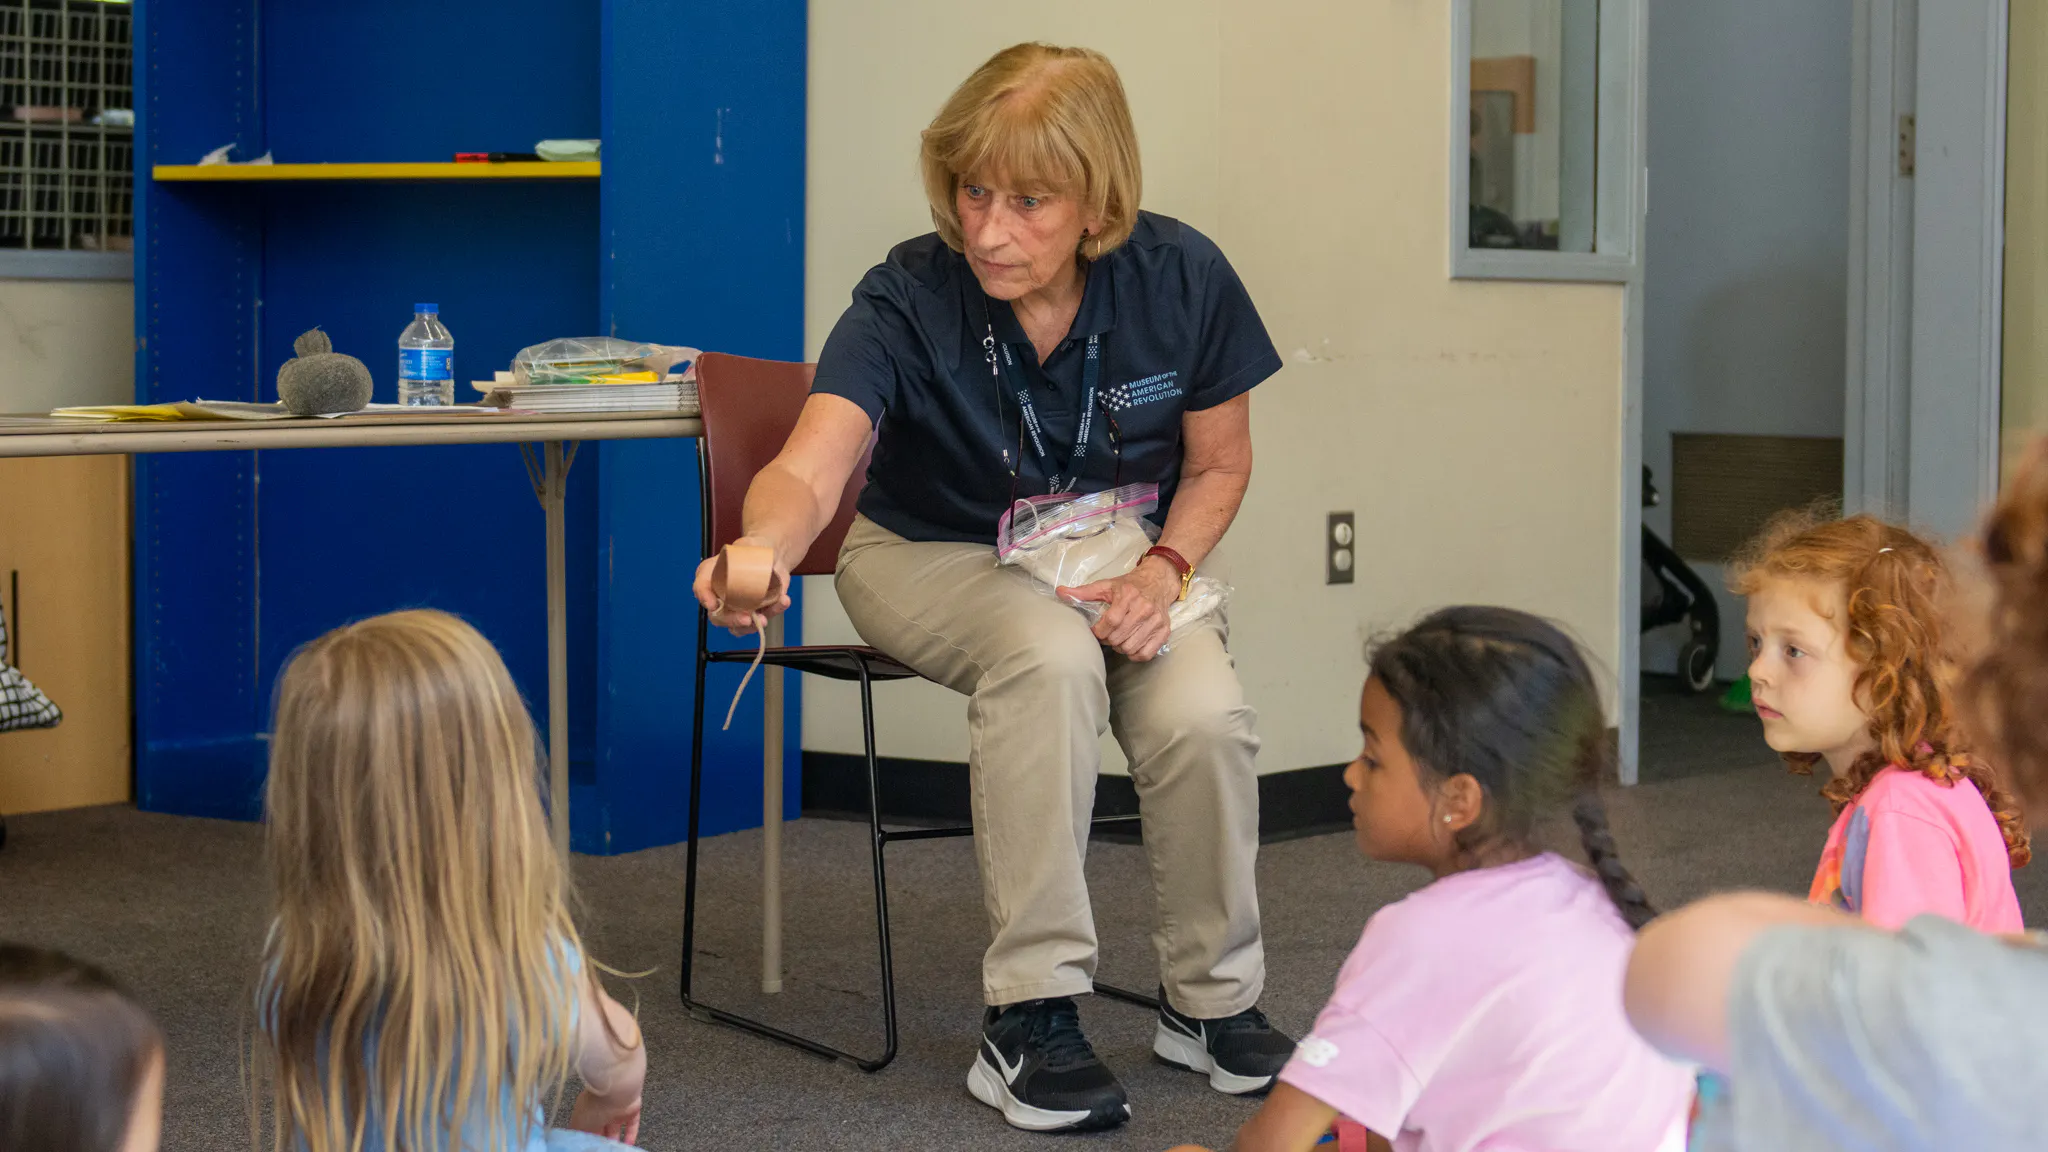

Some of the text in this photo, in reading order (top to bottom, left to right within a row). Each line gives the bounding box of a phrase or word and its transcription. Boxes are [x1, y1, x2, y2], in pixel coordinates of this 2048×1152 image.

[1129, 374, 1161, 389] MUSEUM
[1131, 380, 1174, 397] AMERICAN
[1132, 388, 1182, 406] REVOLUTION
[1083, 418, 1091, 443] AMERICAN
